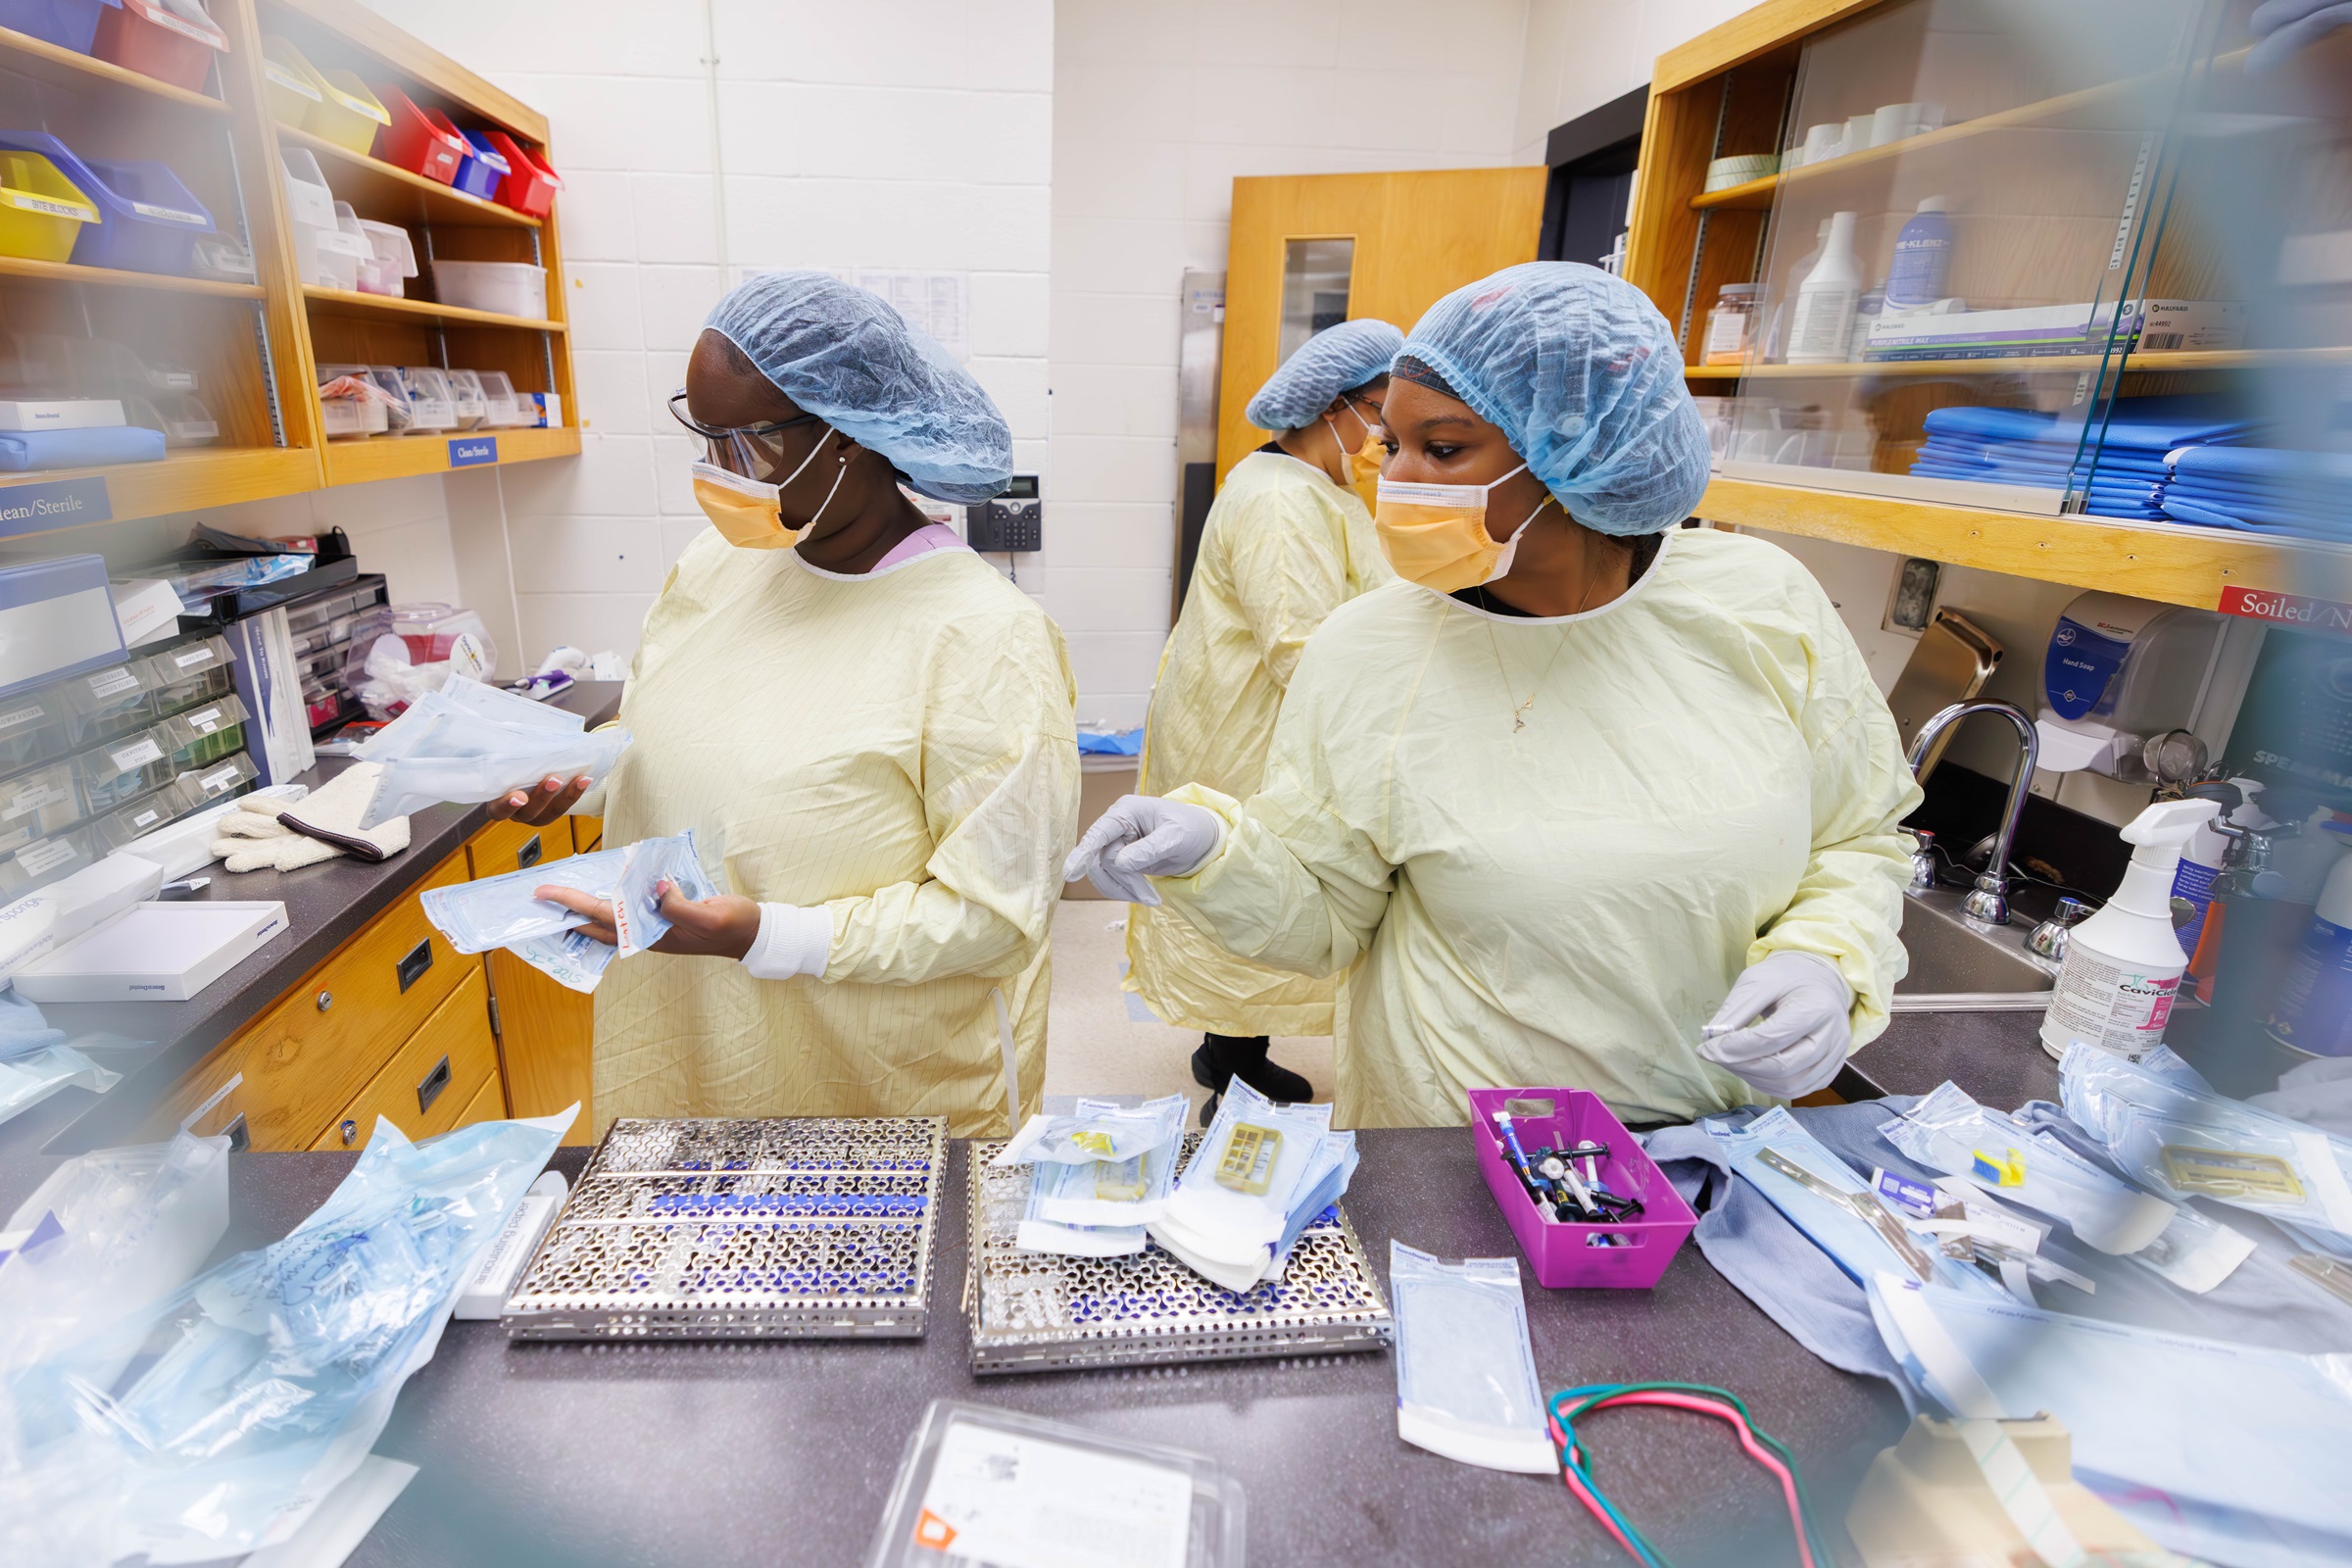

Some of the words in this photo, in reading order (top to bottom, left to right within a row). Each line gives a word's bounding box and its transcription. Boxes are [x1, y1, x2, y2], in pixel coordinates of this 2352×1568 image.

[31, 199, 49, 212] BITE
[50, 203, 79, 218] BLOCKS
[1915, 336, 1930, 345] MAX
[458, 445, 489, 459] Clean/Sterile
[2063, 658, 2080, 668] Hand
[2079, 661, 2095, 672] Soap
[122, 743, 150, 760] CAVITRON
[1235, 1080, 1261, 1102] BencoDental
[473, 1228, 511, 1287] articulating
[512, 1200, 531, 1231] paper
[1396, 1246, 1431, 1263] BencoDental
